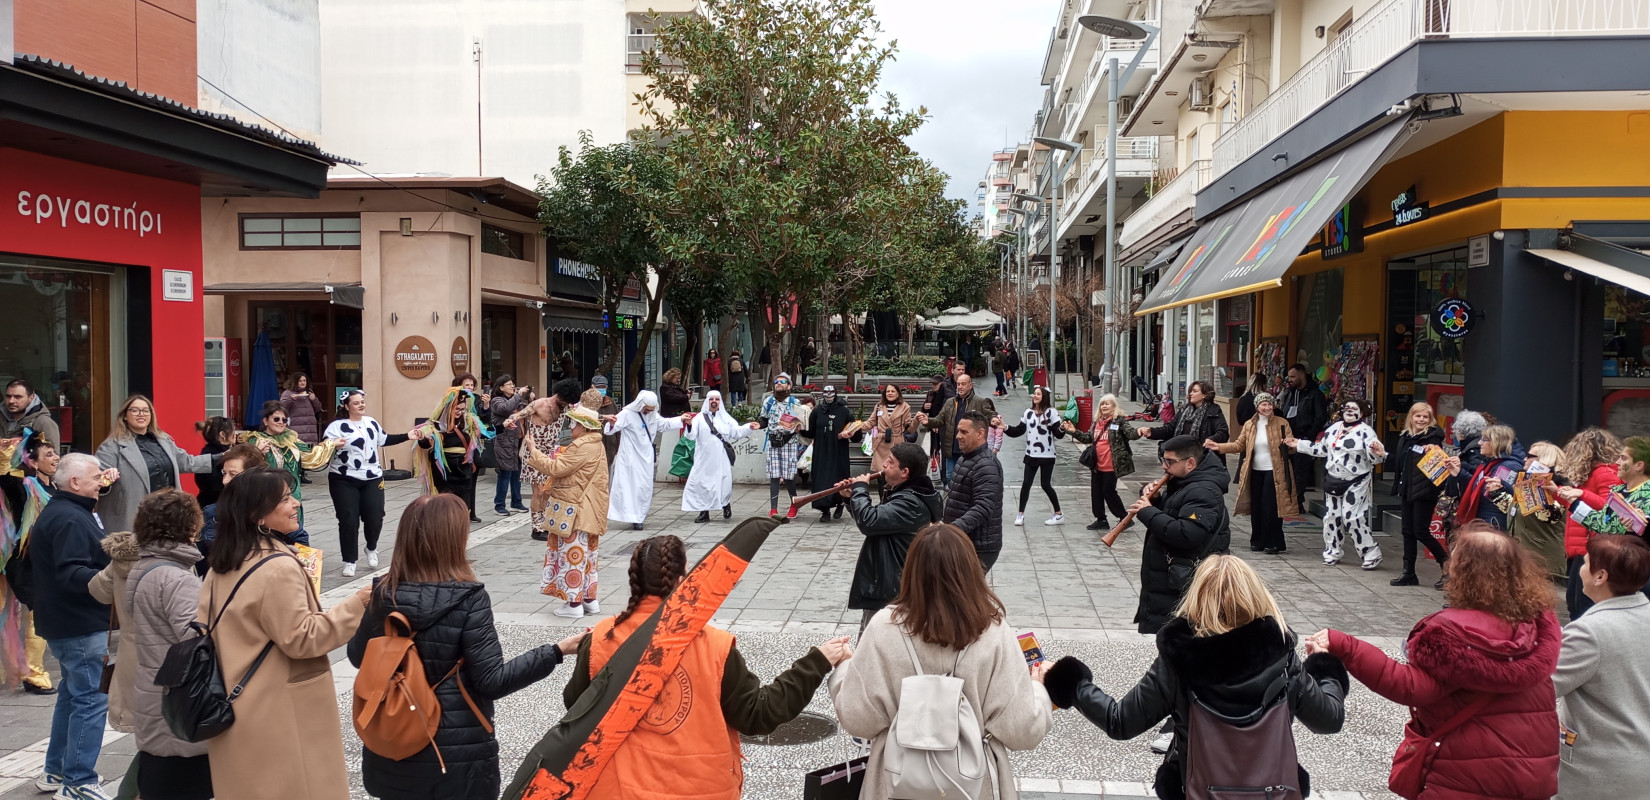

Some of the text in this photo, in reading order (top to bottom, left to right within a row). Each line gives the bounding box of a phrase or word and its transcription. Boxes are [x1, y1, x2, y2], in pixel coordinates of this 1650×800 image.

[18, 190, 162, 237] εργαστήρι
[1324, 244, 1343, 257] STORES
[396, 352, 435, 361] STRAGALATTE
[675, 671, 691, 724] ΠΟΛΥΓΥΡΟΥ
